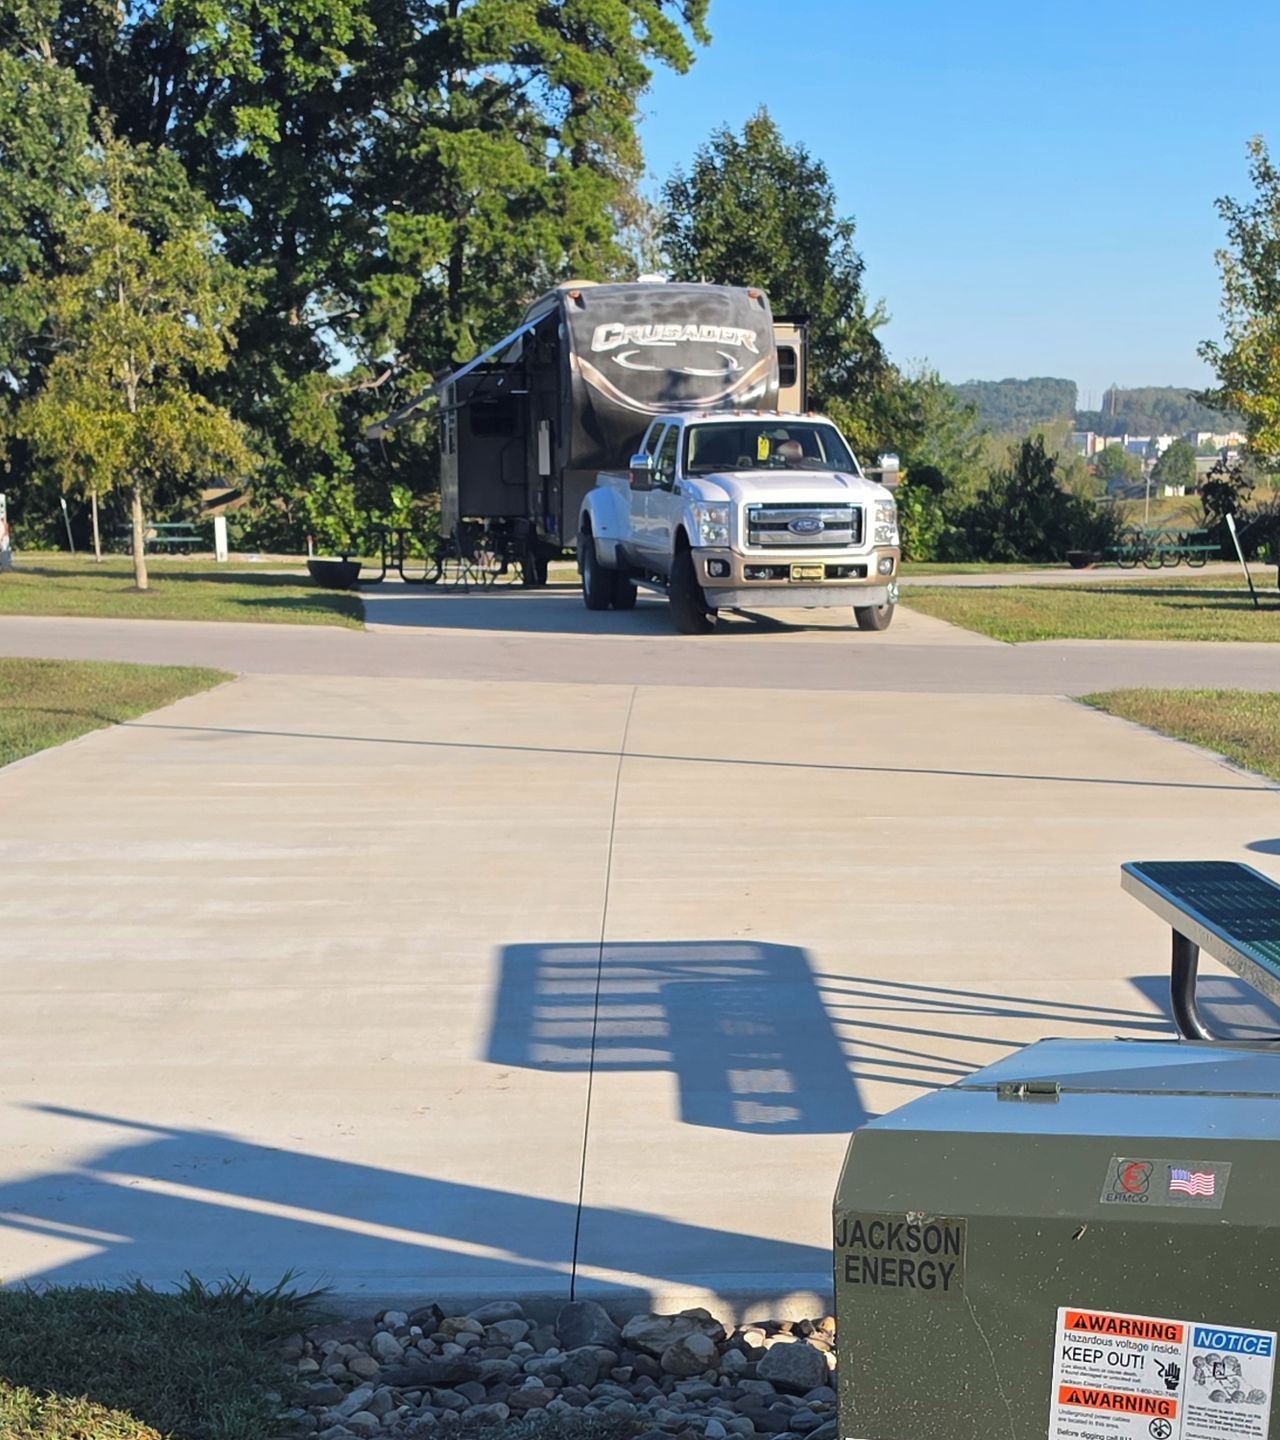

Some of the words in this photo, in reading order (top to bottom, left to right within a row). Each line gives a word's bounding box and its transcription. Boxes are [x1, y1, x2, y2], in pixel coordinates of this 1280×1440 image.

[591, 322, 760, 354] CRUSADER
[836, 1219, 960, 1256] JACKSON
[844, 1254, 956, 1292] ENERGY
[1088, 1315, 1177, 1341] WARNING
[1063, 1332, 1113, 1347] Hazardous
[1115, 1340, 1149, 1353] voltage
[1151, 1343, 1182, 1356] inside.
[1196, 1330, 1271, 1355] NOTICE
[1062, 1346, 1104, 1364] KEEP
[1107, 1351, 1145, 1370] OUT!
[1081, 1390, 1170, 1416] WARNING
[1056, 1427, 1080, 1438] Before
